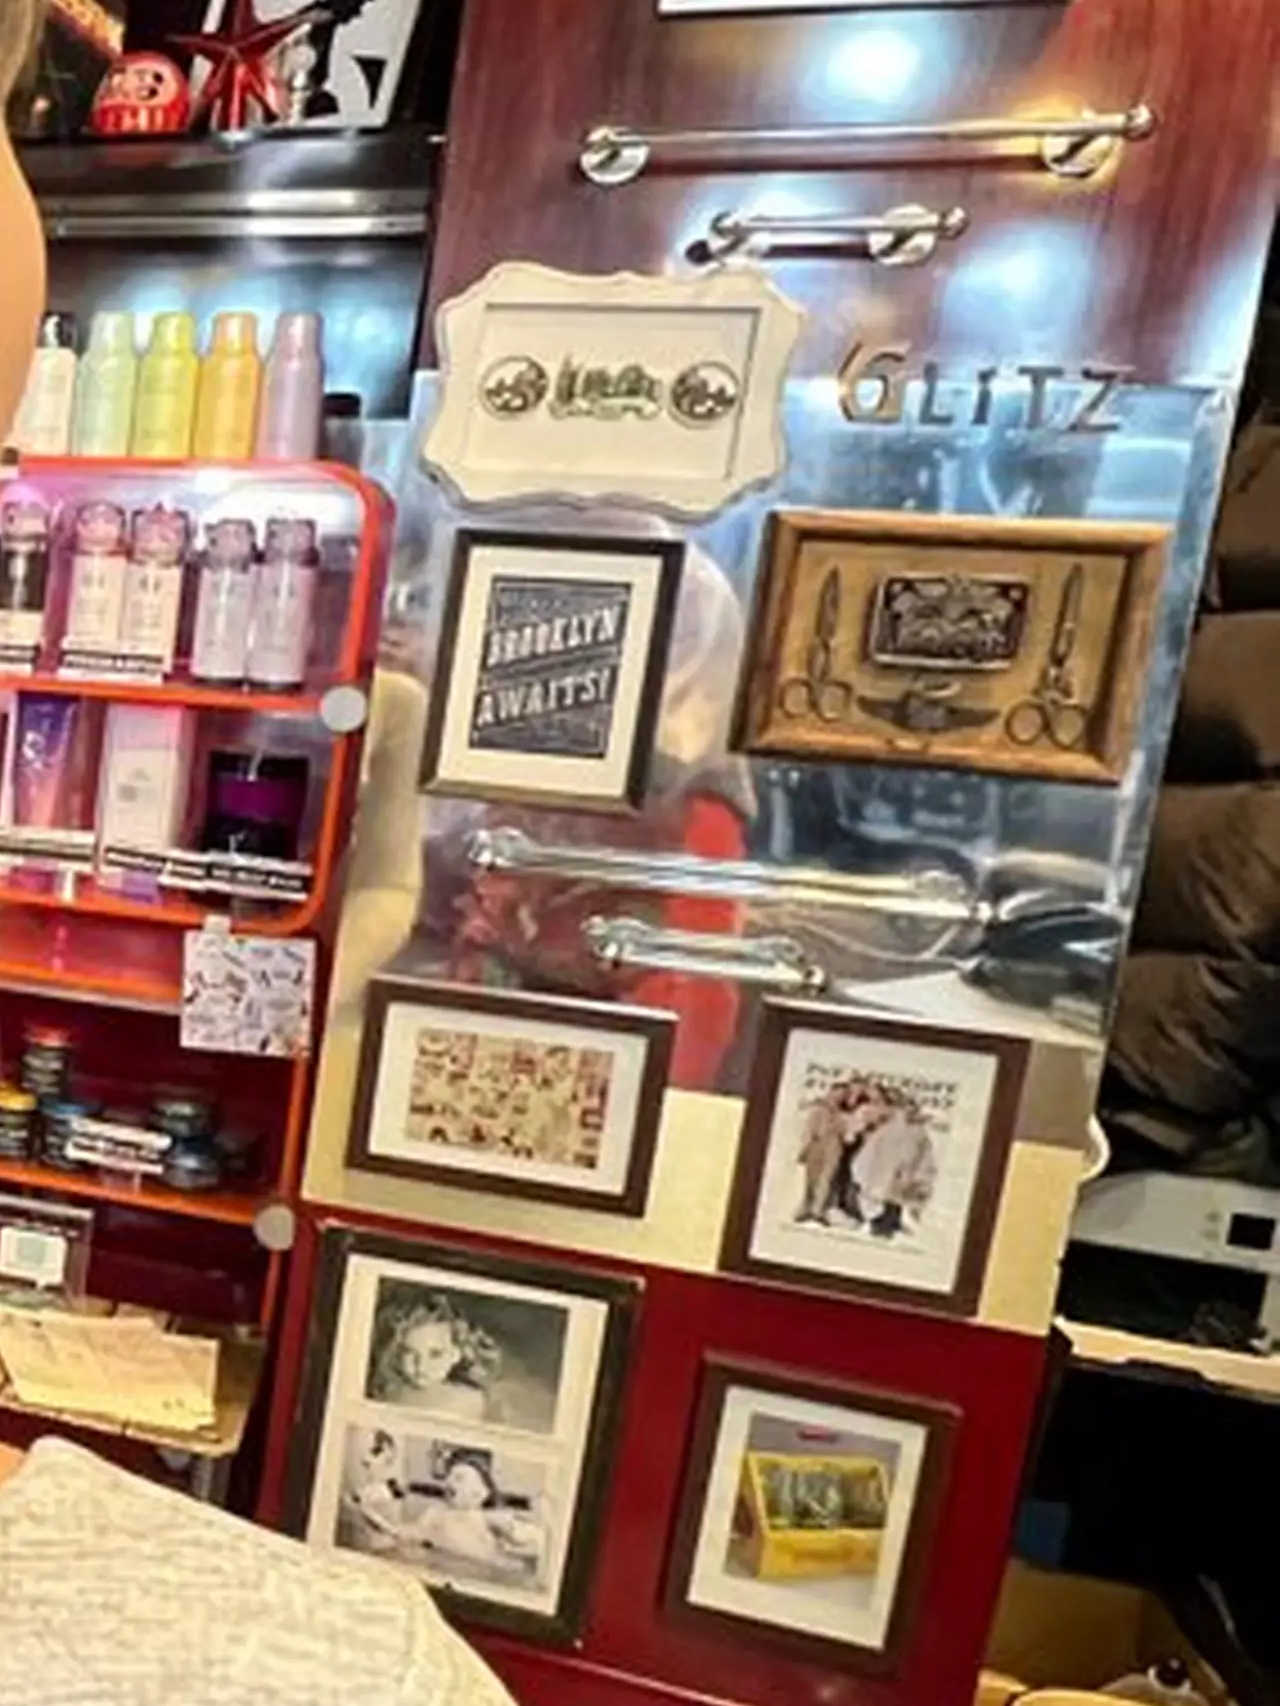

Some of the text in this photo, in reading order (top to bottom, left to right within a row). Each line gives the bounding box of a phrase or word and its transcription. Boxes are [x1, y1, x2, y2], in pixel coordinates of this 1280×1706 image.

[837, 339, 1132, 432] GLITZ
[487, 604, 621, 667] BROOKLYN
[476, 667, 611, 728] AWAITS!
